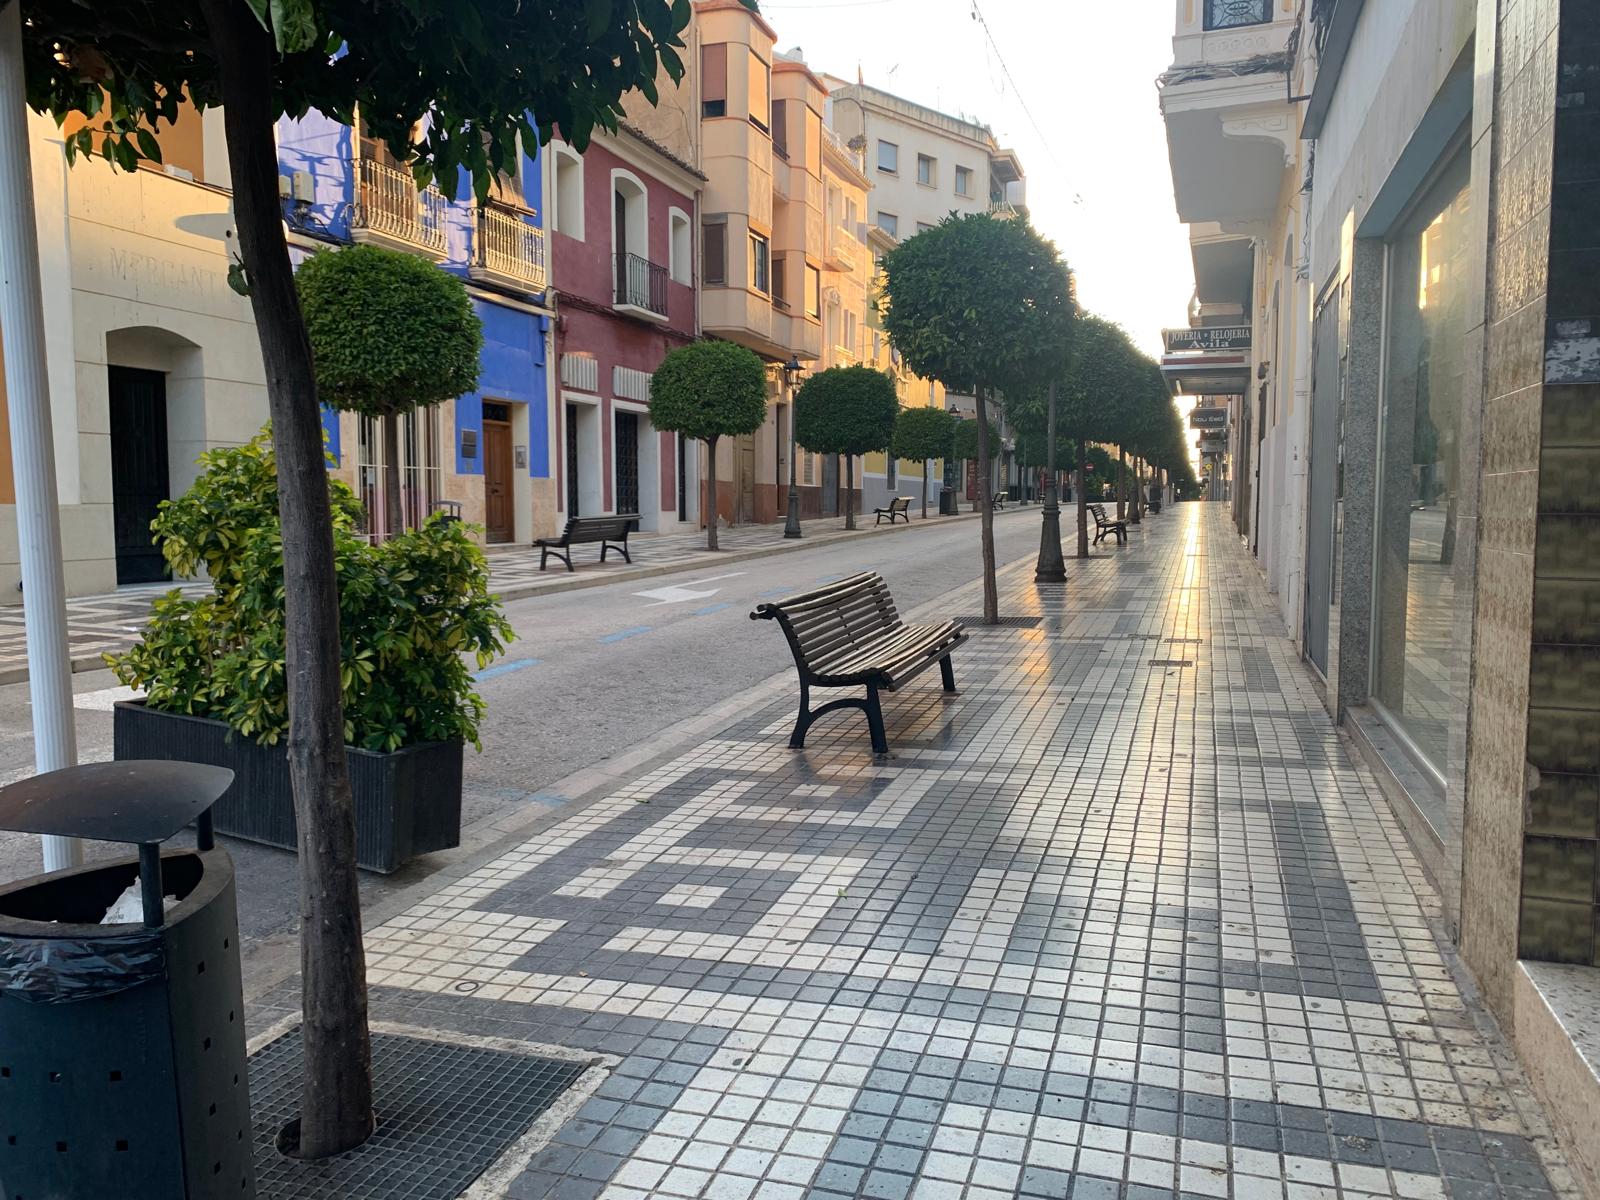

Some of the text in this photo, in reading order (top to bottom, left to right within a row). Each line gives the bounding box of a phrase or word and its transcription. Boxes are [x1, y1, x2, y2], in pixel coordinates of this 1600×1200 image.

[1170, 329, 1250, 343] JOYERIA RELOJERIA
[1188, 340, 1229, 348] Avila
